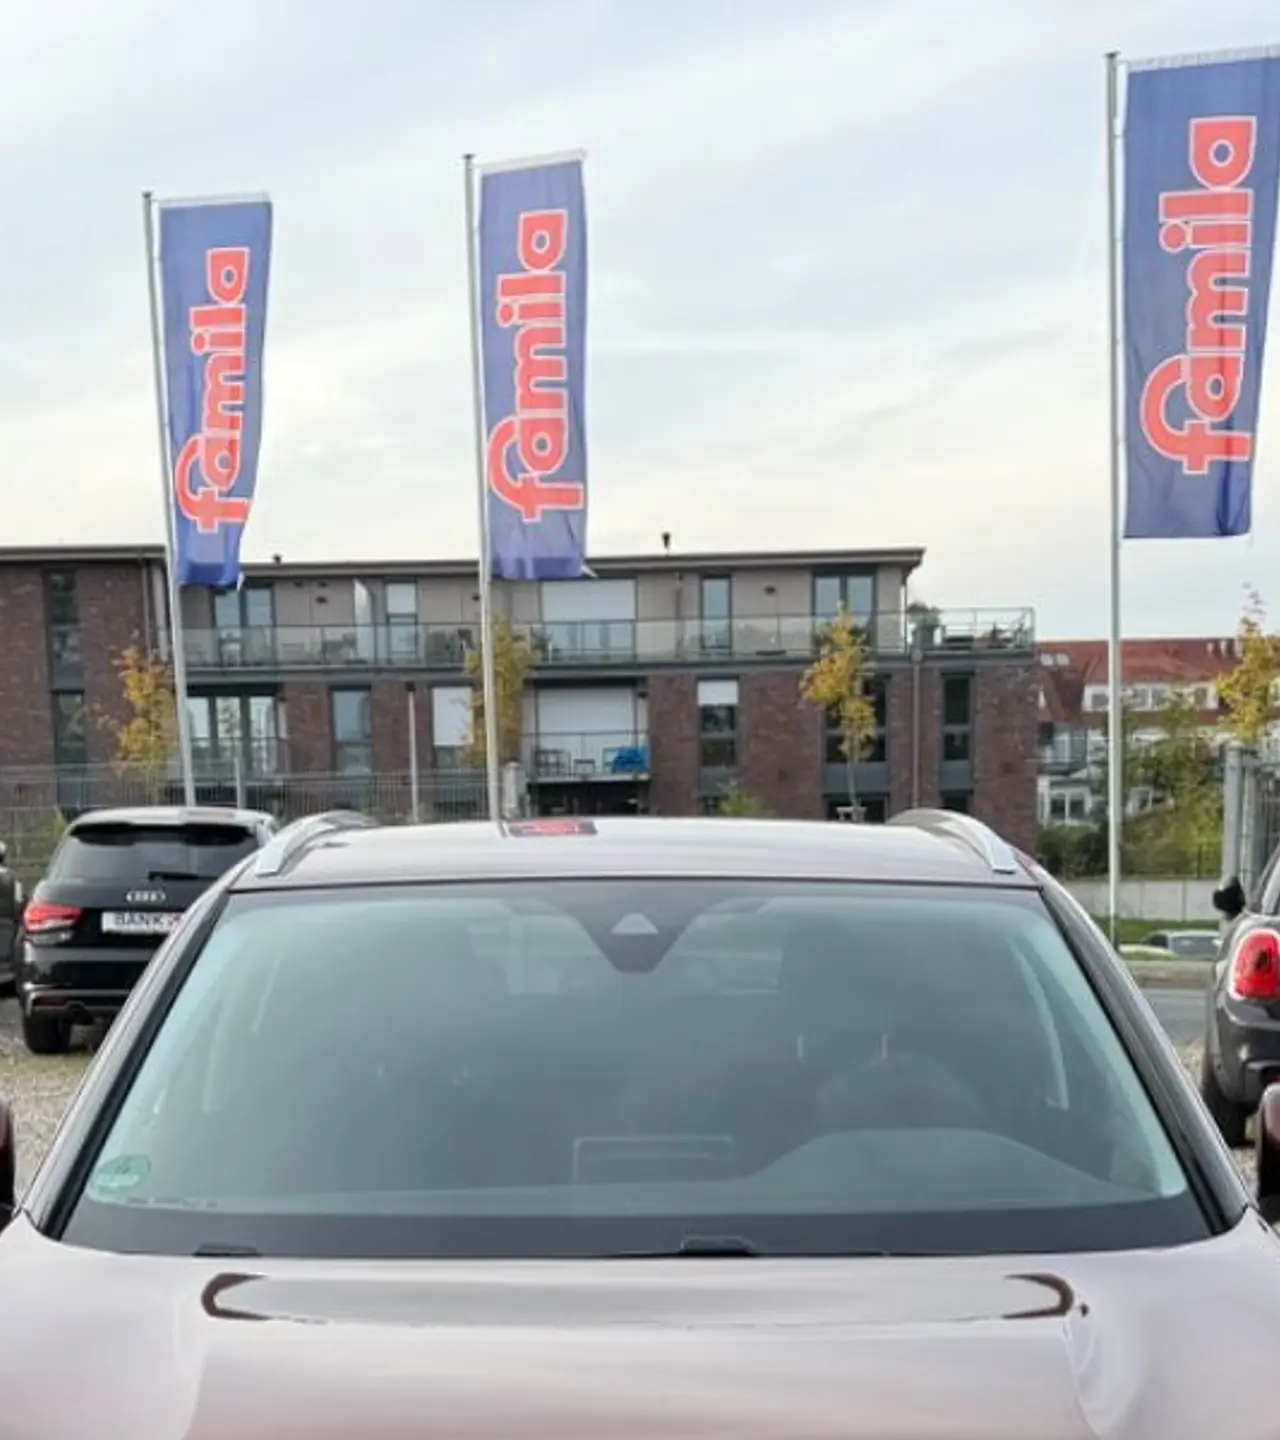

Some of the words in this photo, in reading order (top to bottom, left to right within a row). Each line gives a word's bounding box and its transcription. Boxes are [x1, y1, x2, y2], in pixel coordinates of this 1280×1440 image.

[174, 246, 250, 534] famila
[487, 208, 584, 522] famila
[1140, 116, 1257, 474] famila
